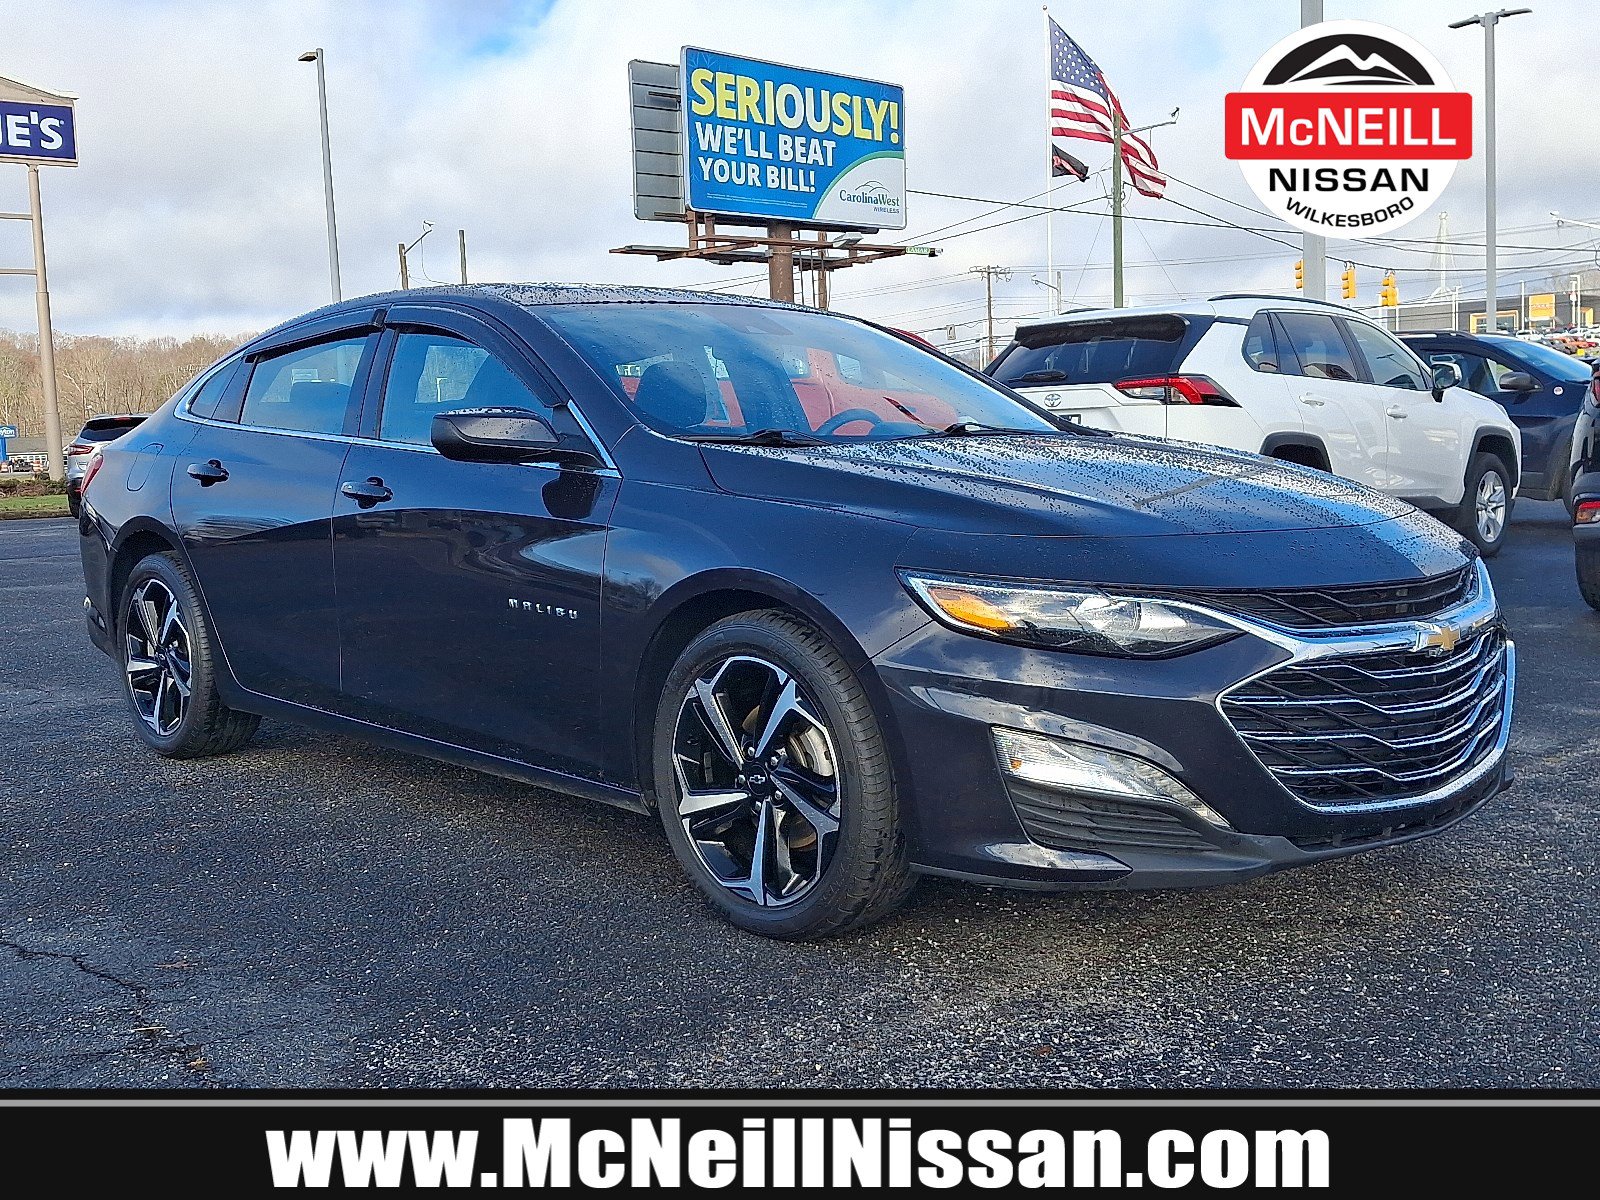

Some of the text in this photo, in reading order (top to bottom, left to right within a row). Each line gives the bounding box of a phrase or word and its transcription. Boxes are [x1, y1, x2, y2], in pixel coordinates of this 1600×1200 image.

[691, 68, 899, 144] SERIOUSLY!
[0, 110, 63, 150] E'S
[695, 121, 837, 167] WE'LL BEAT
[697, 156, 816, 193] YOUR BILL!
[873, 206, 900, 214] WIRELESS
[508, 598, 578, 620] MALIBU
